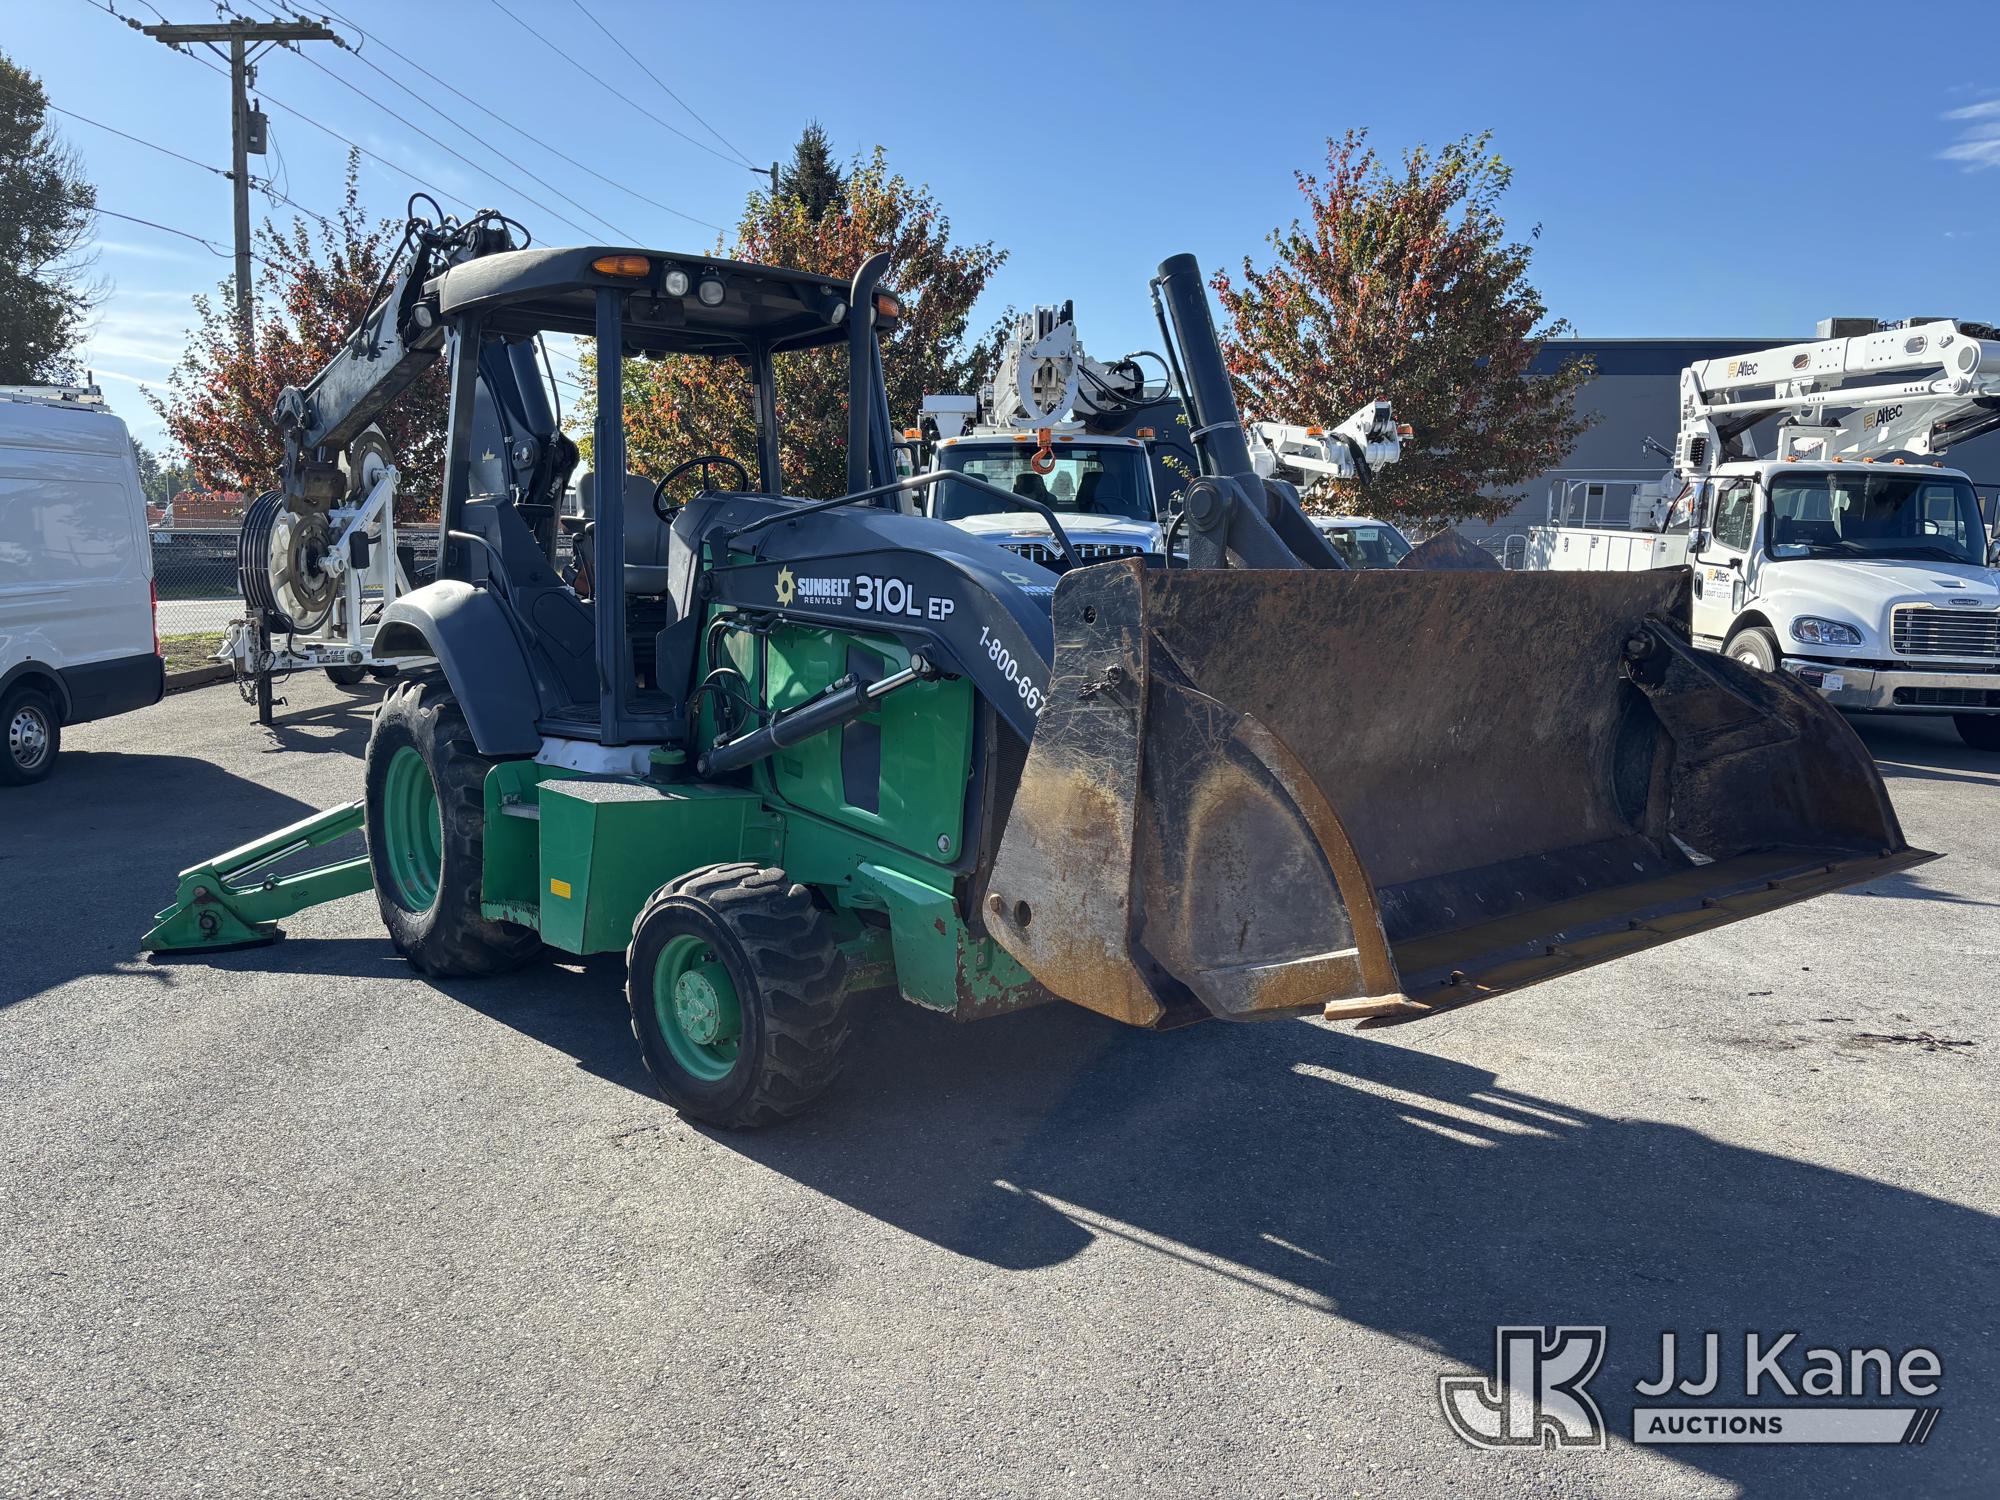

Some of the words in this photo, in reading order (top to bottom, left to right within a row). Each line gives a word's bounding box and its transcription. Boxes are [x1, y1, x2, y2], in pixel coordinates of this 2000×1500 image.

[1736, 360, 1759, 377] Altec
[1876, 404, 1903, 427] Altec
[1713, 569, 1730, 583] Altec
[797, 578, 851, 597] SUNBELT
[804, 597, 842, 605] RENTALS
[855, 575, 922, 617] 310L
[928, 597, 955, 621] EP
